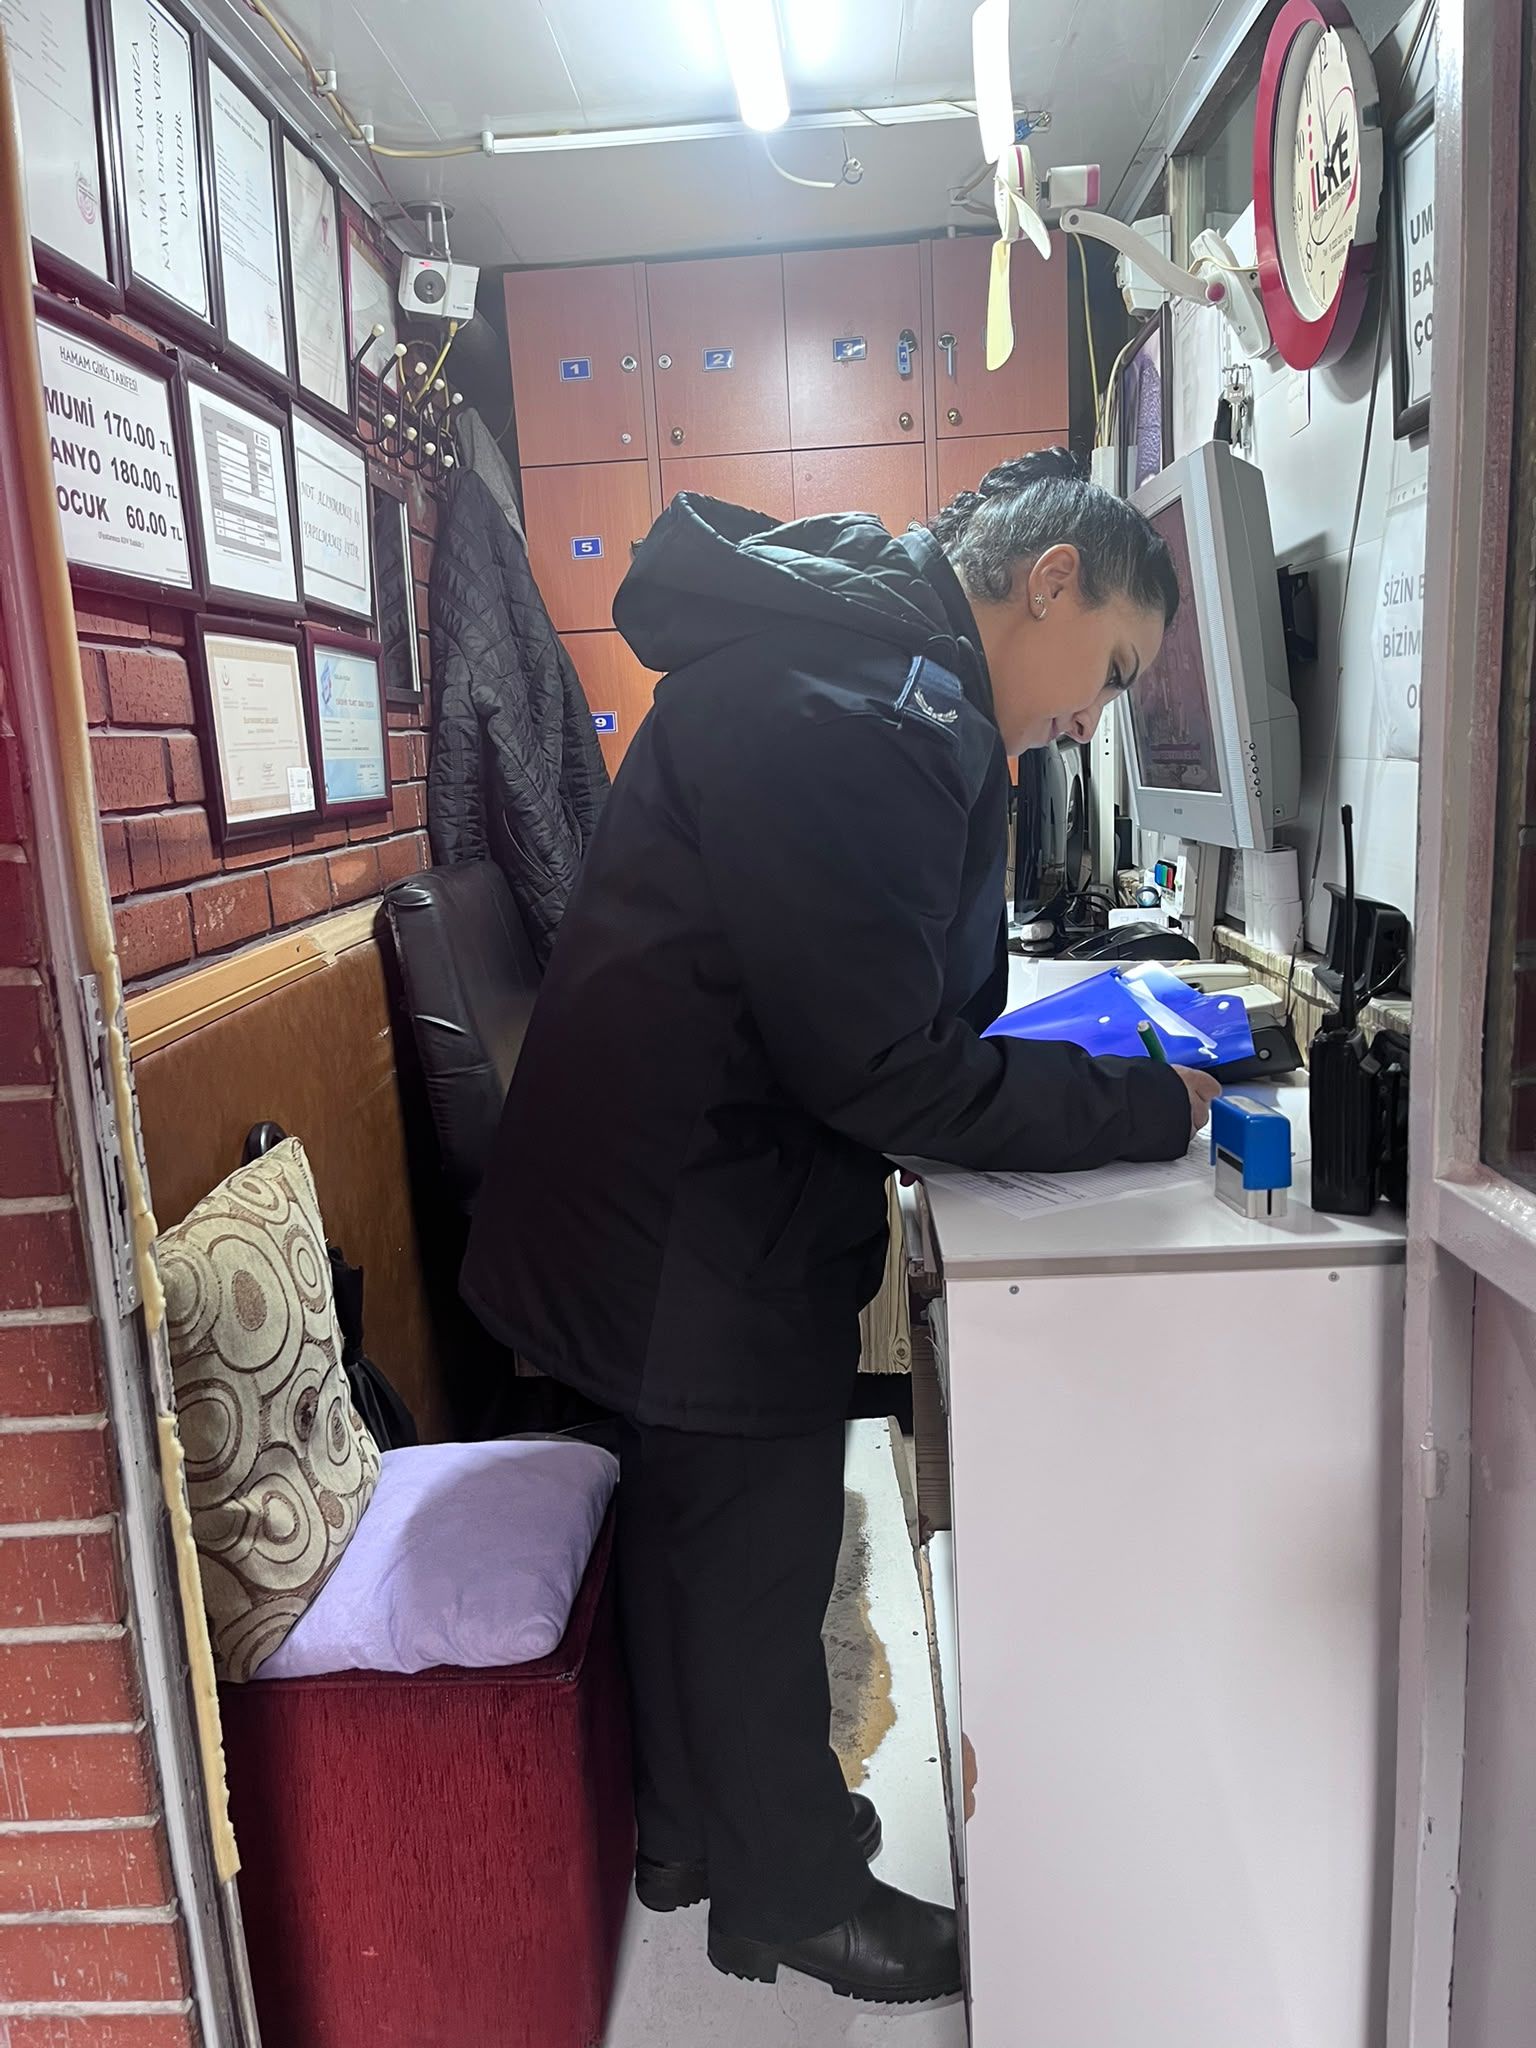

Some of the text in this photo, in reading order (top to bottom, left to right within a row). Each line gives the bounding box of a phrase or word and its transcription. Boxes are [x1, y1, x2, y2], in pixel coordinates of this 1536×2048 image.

[1410, 203, 1434, 245] UM
[1412, 260, 1434, 298] BA
[1414, 312, 1434, 356] ÇO
[569, 364, 579, 375] 1
[713, 353, 724, 364] 2
[44, 386, 172, 457] MUMİ 170.00 TL
[52, 436, 178, 499] ANYO 180.00 TL
[57, 485, 110, 523] OCUK
[126, 505, 167, 537] 60.00
[170, 526, 182, 541] TL
[581, 541, 593, 553] 5
[1382, 571, 1414, 607] SİZİN
[595, 717, 607, 728] 9
